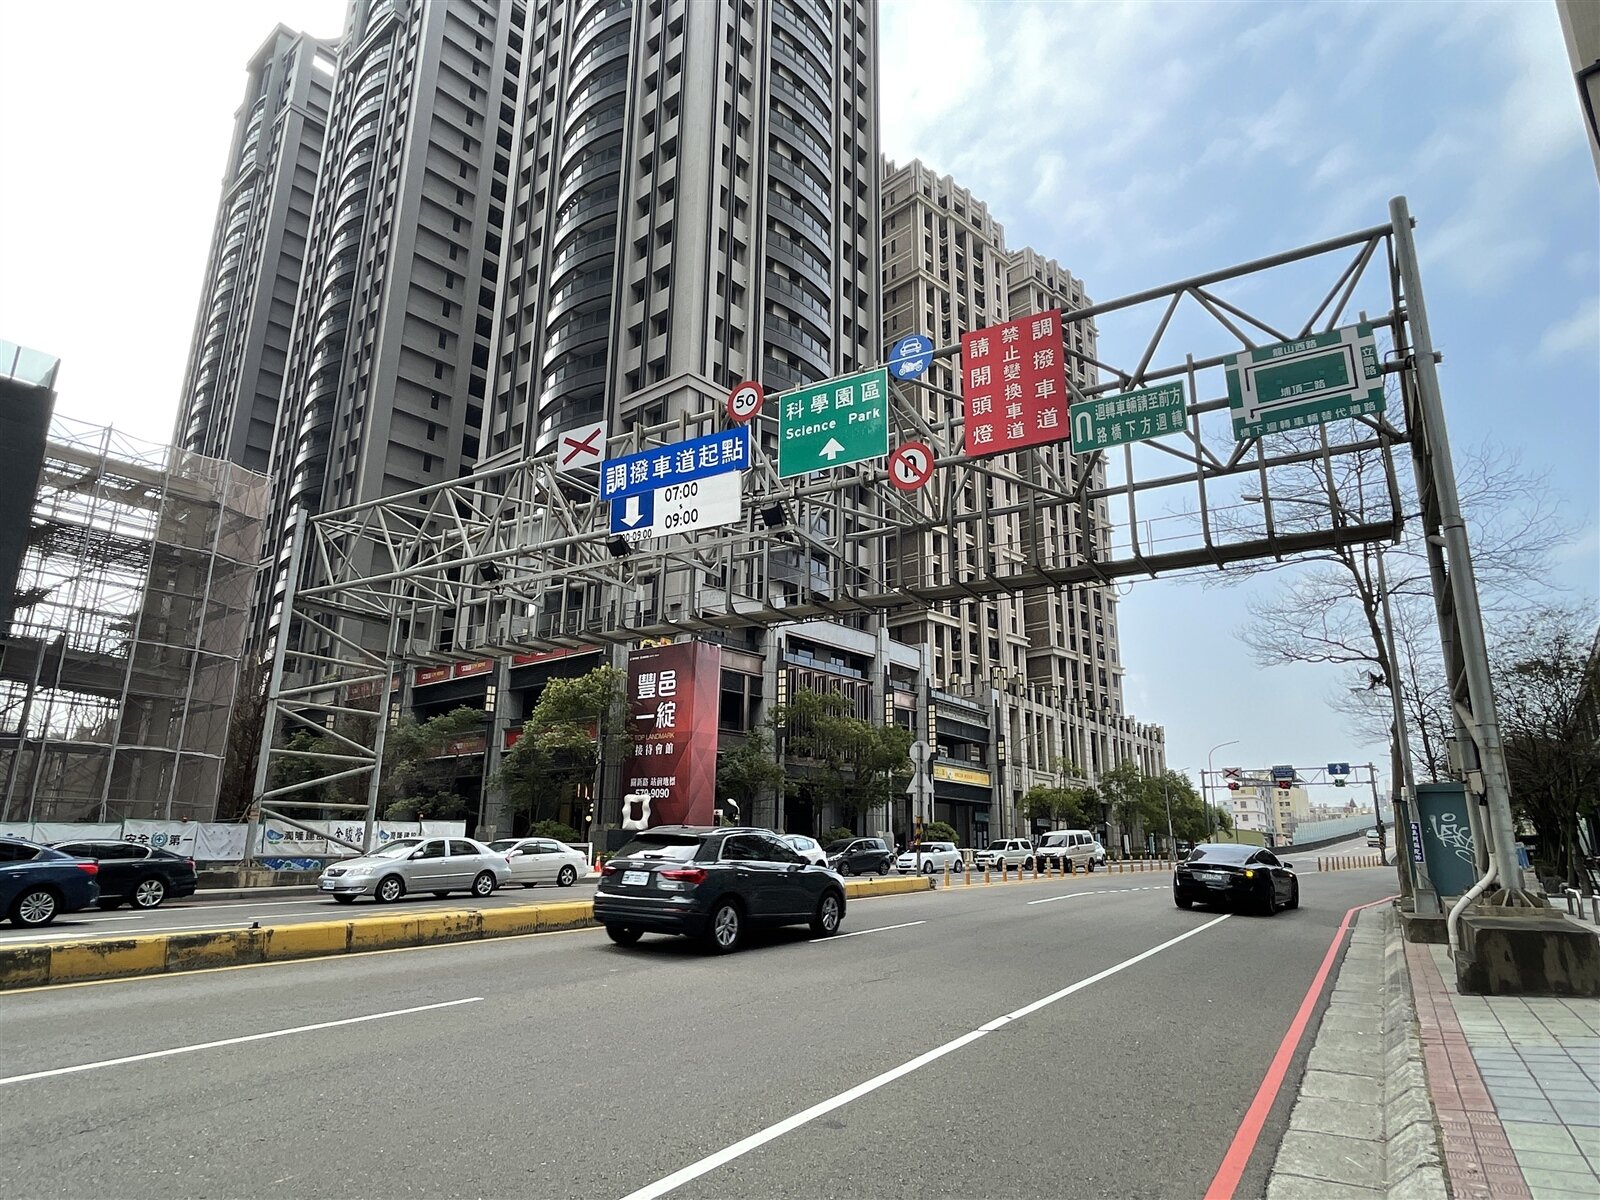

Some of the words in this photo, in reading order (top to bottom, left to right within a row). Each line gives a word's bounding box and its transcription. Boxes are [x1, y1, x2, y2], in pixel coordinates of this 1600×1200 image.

[1001, 325, 1025, 440] 禁止變換車道
[1031, 317, 1059, 430] 調撥車道
[735, 393, 756, 409] 50
[786, 379, 881, 421] 科學園區
[969, 337, 994, 445] 請開頭燈
[1094, 386, 1181, 422] 迴轉車輛請至前方
[785, 418, 837, 440] Science
[848, 407, 881, 424] Park
[1096, 411, 1184, 444] 路橋下方迴轉
[605, 436, 744, 495] 調撥車道起點
[664, 481, 699, 502] 07:00
[664, 508, 699, 529] 09:00
[637, 669, 677, 699] 豐邑
[645, 732, 675, 741] LANDMARK
[124, 833, 150, 845] 安全
[168, 834, 193, 846] 第一
